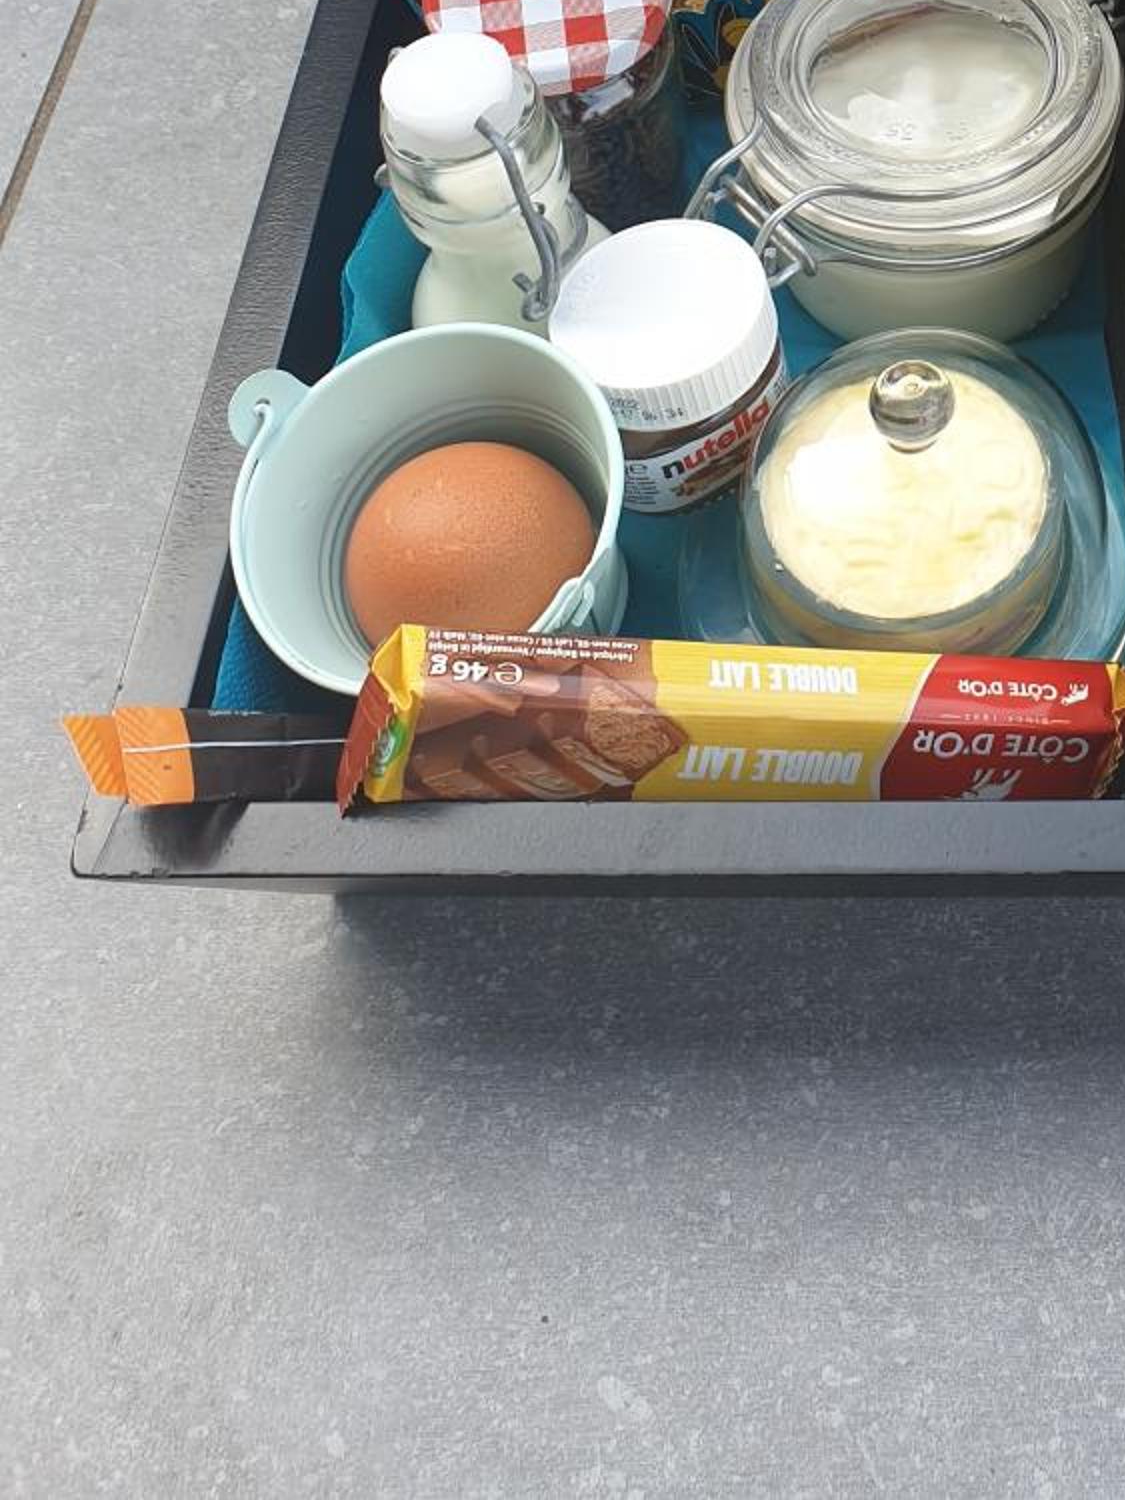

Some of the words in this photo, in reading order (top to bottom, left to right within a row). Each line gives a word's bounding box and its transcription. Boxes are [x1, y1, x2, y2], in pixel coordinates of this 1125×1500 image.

[661, 399, 770, 479] nutella
[428, 653, 449, 676] g
[452, 659, 489, 682] 46
[708, 659, 762, 692] LAIT
[766, 662, 859, 695] DOUBLE
[912, 729, 996, 760] D'OR
[1002, 732, 1090, 764] CÔTE
[676, 744, 748, 782] LAIT
[752, 748, 865, 785] DOUBLE
